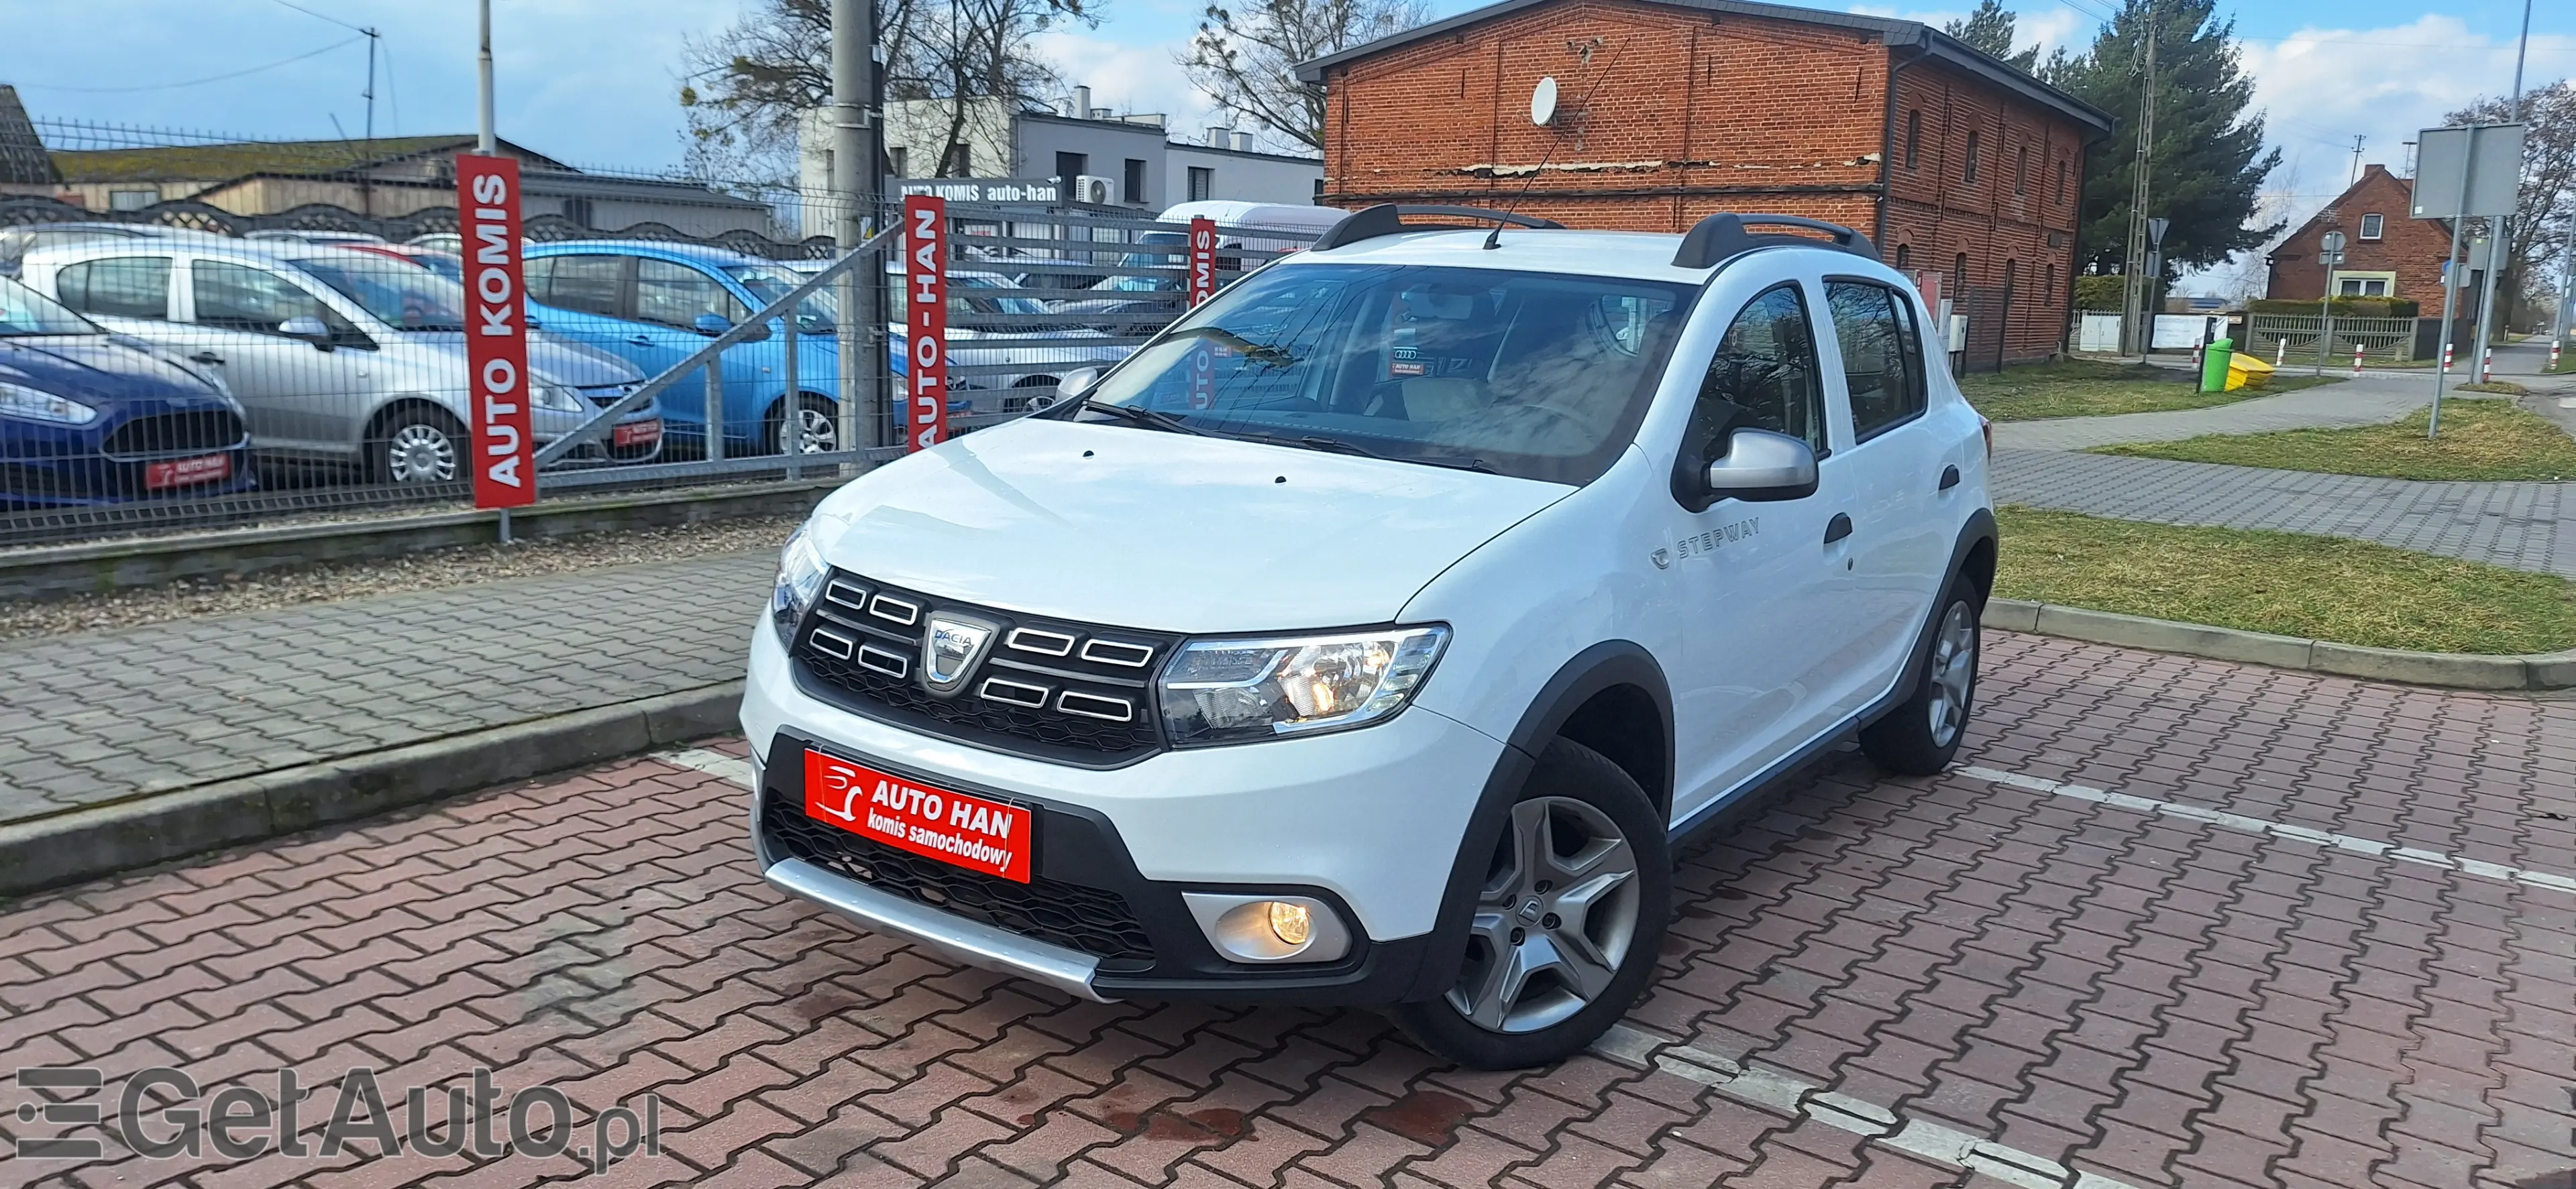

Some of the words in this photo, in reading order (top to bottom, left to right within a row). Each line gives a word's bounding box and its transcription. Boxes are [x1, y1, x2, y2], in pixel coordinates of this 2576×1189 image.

[935, 184, 980, 202] KOMIS
[987, 184, 1057, 202] auto-han
[472, 174, 513, 336] KOMIS
[1195, 349, 1209, 410] UTO
[483, 357, 521, 488] AUTO
[1677, 516, 1760, 560] STEPWAY
[934, 629, 972, 646] DACIA
[867, 807, 906, 839] komis
[908, 825, 1013, 873] samochodowy
[871, 779, 943, 821] AUTO
[949, 800, 1014, 840] HAN
